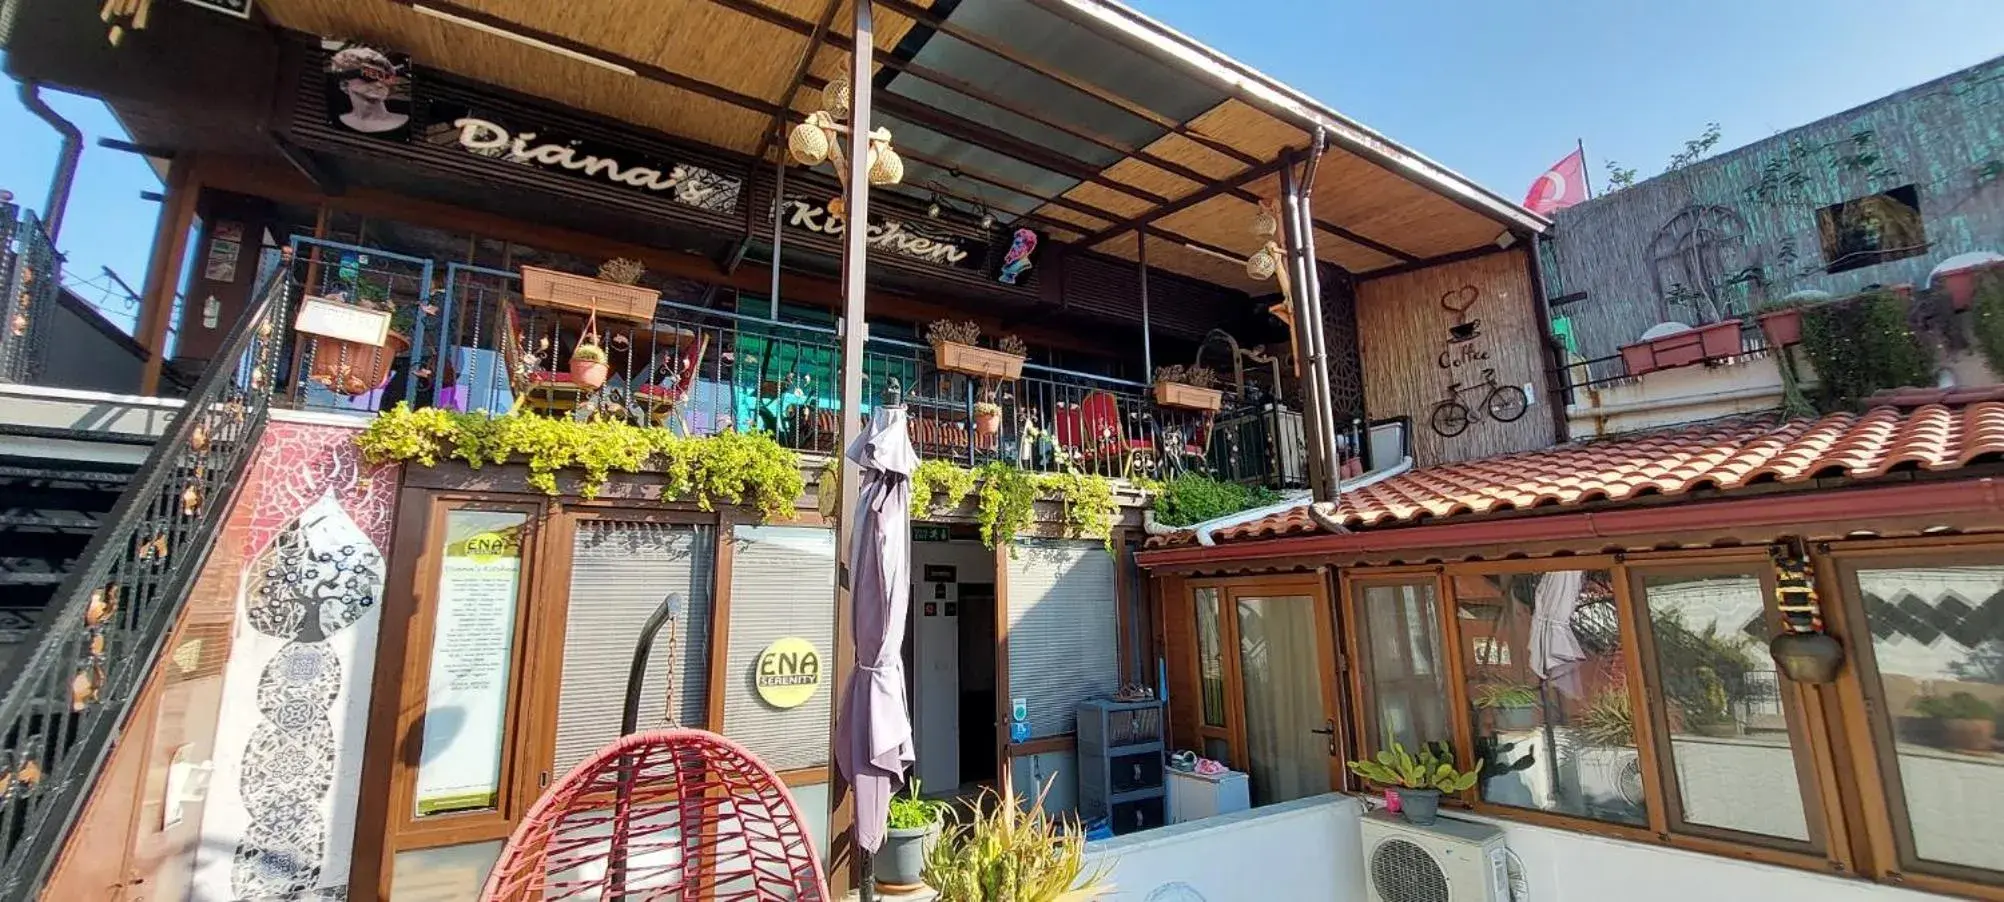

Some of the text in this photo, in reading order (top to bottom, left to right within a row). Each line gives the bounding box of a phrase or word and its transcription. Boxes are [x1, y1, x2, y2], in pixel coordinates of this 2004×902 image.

[789, 200, 968, 263] Kichen
[1438, 342, 1490, 369] Coffee
[467, 539, 503, 551] ENA
[761, 652, 818, 675] ENA
[760, 675, 818, 686] SERENITY
